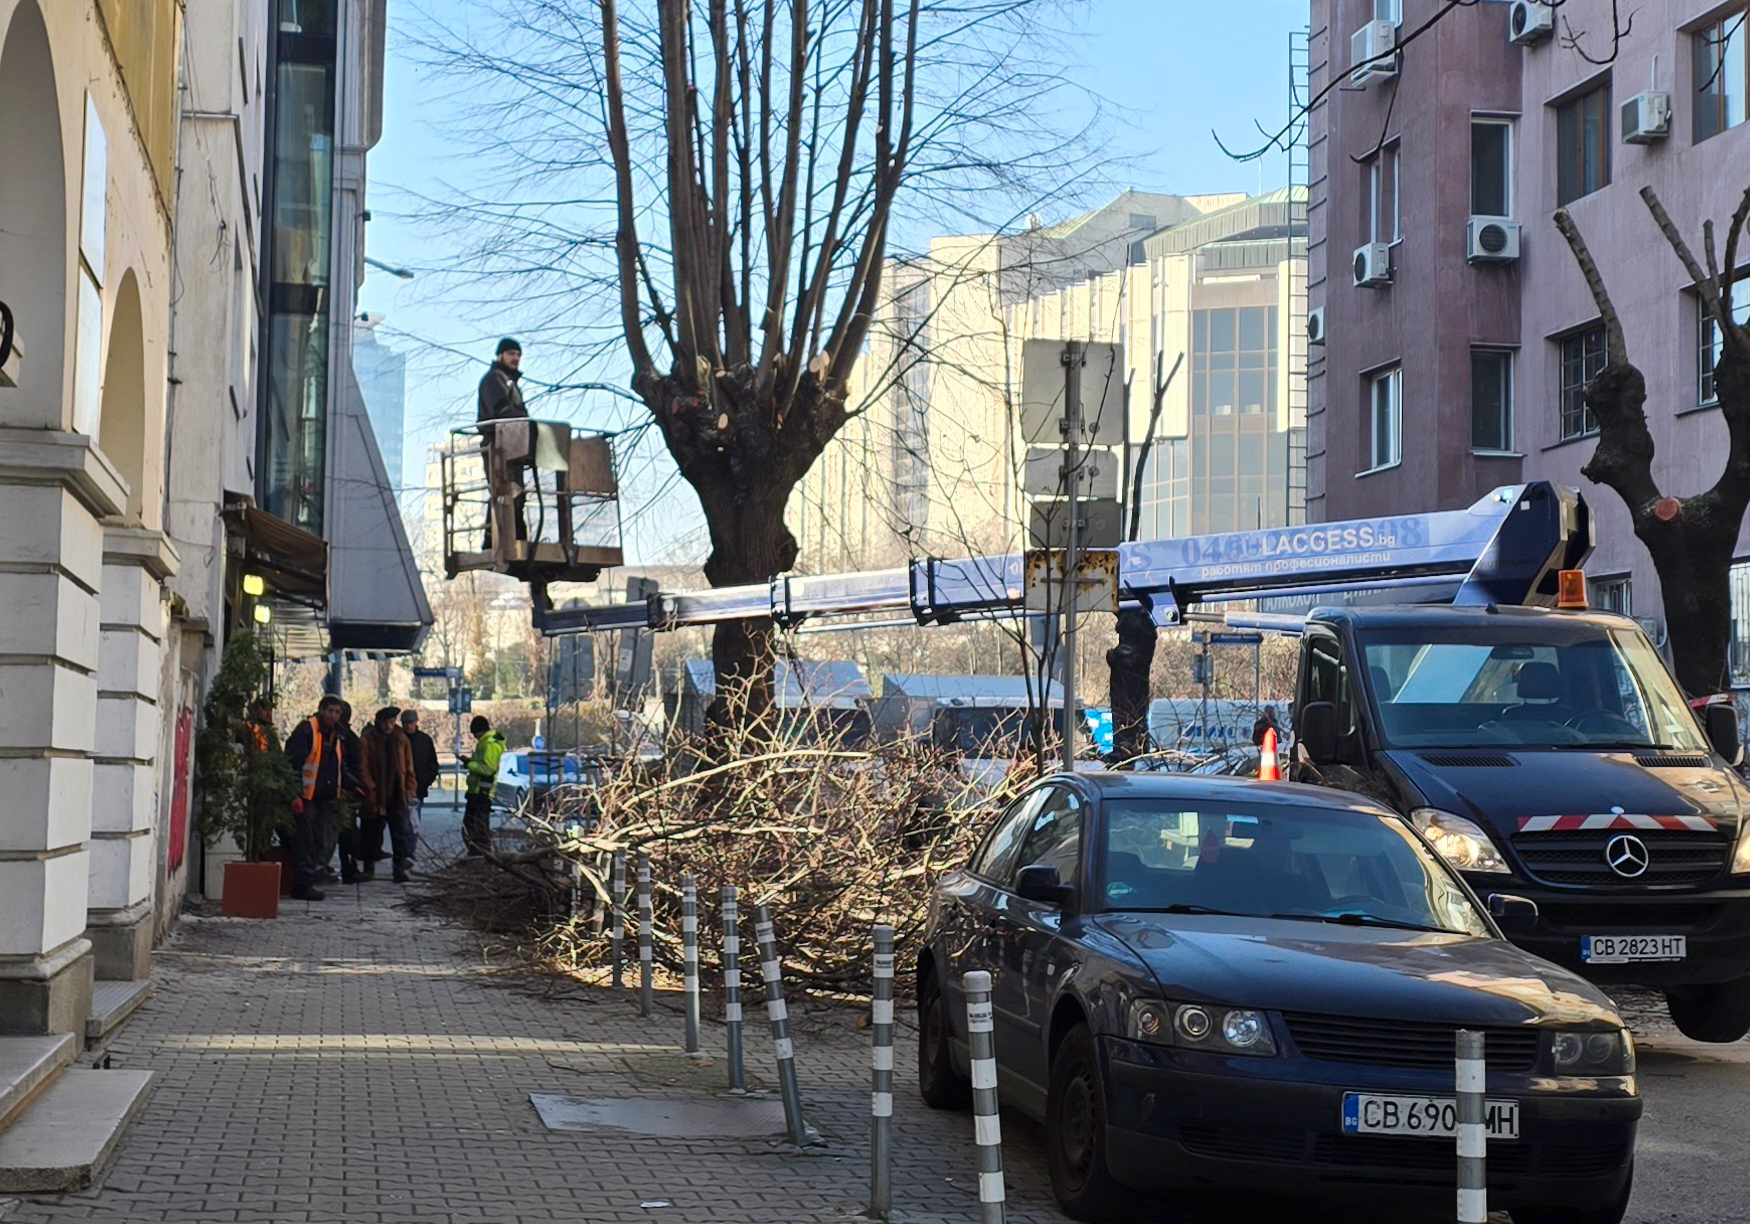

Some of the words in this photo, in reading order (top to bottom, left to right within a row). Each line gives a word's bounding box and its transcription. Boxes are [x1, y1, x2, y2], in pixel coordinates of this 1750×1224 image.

[1593, 938, 1616, 956] CB
[1618, 938, 1659, 955] 2823
[1661, 938, 1683, 955] HT
[1345, 1116, 1358, 1126] BG
[1363, 1100, 1400, 1129] CB
[1407, 1102, 1457, 1132] 690
